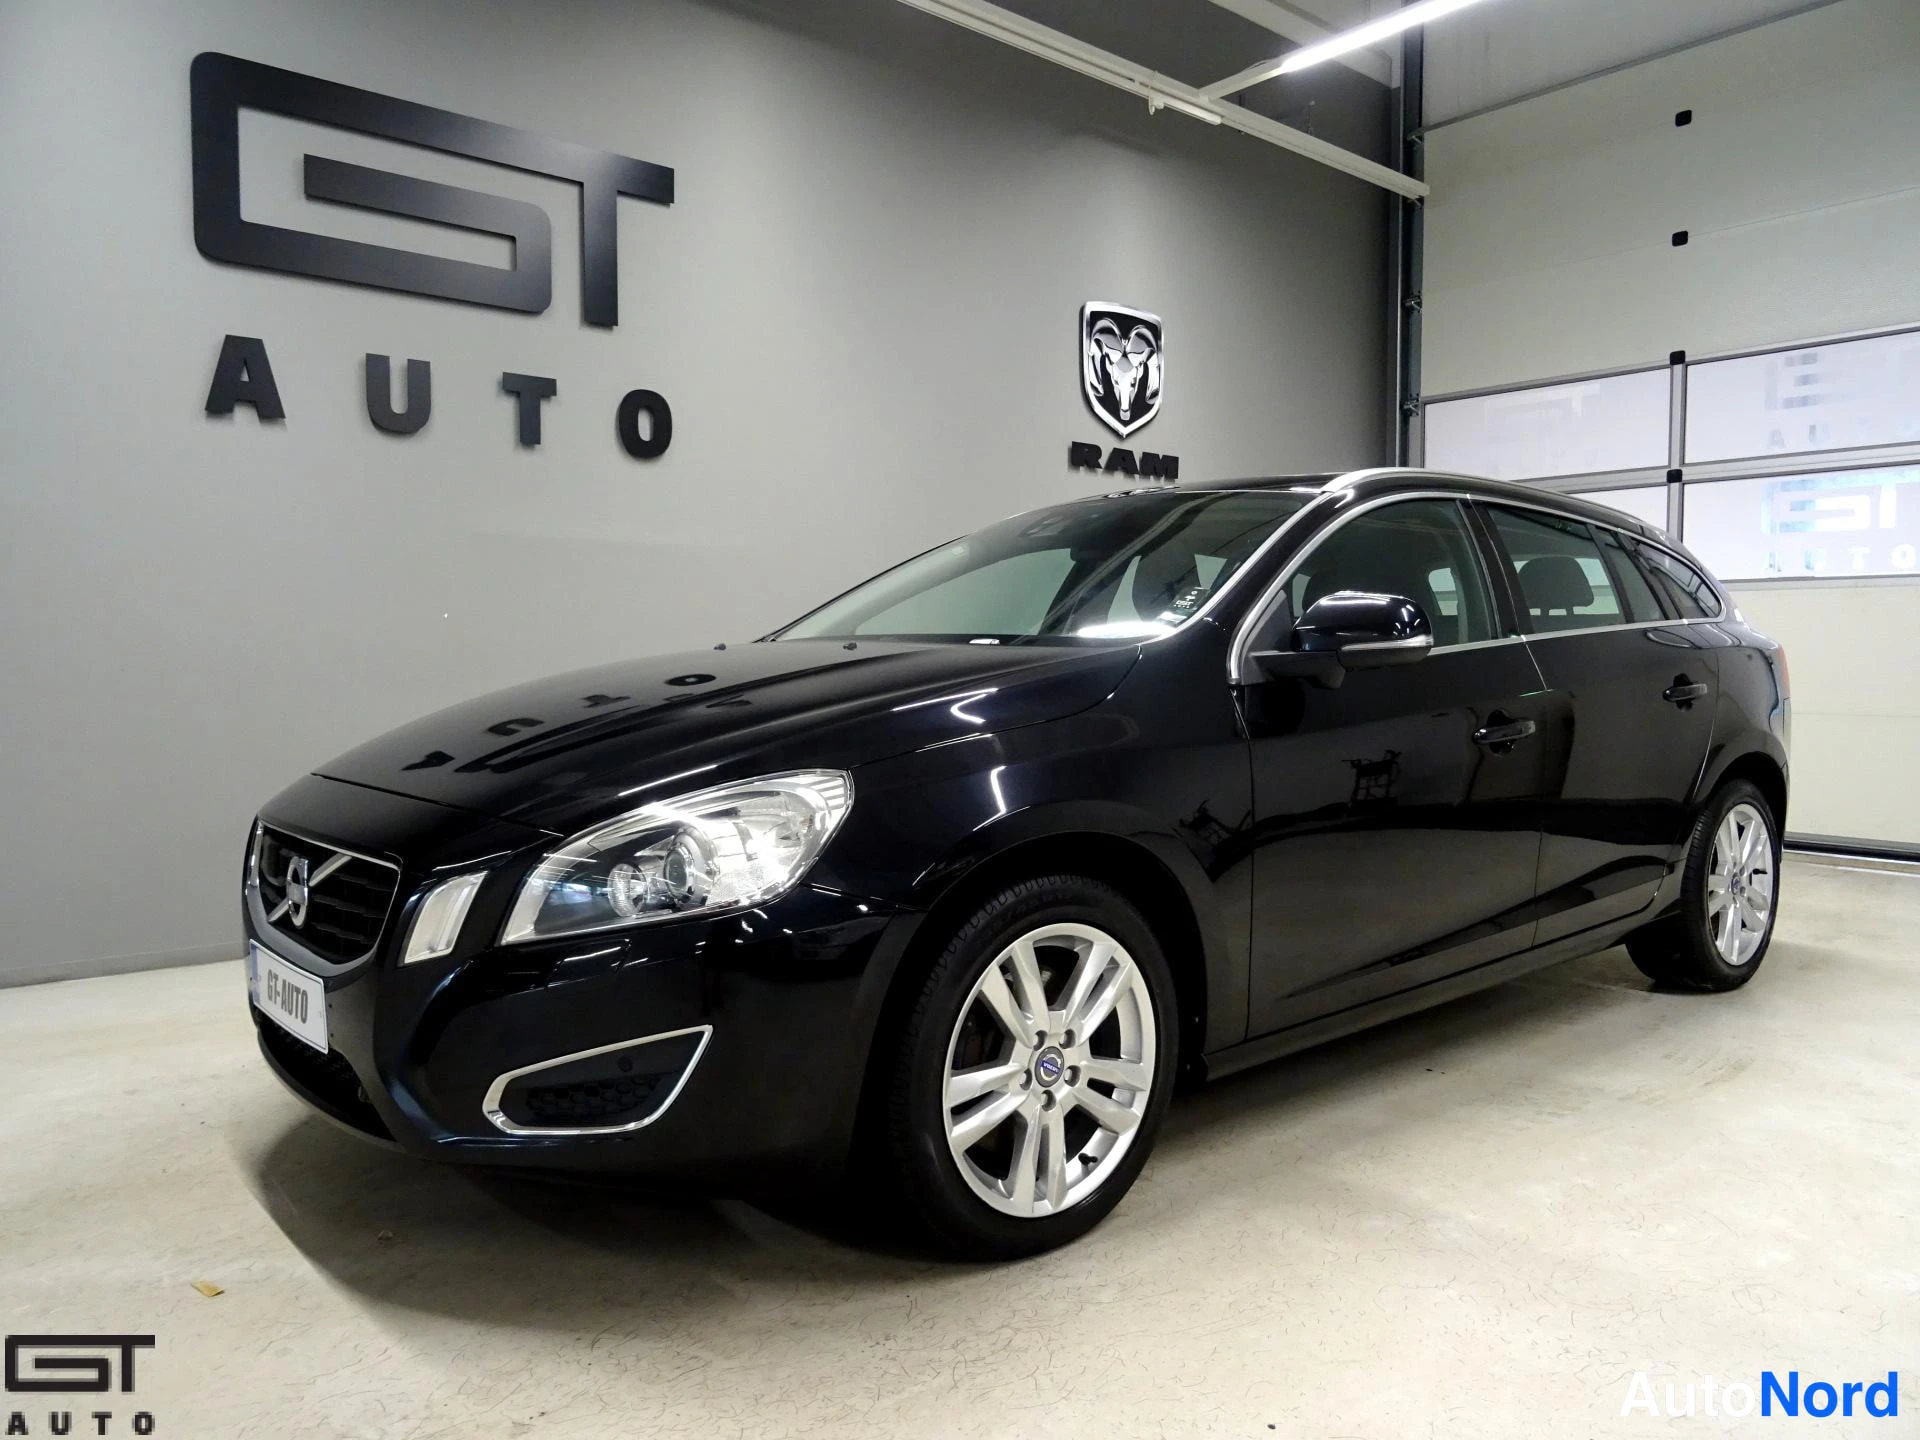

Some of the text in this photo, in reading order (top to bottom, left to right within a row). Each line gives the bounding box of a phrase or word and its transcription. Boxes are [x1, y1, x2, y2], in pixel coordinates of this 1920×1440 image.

[189, 51, 675, 328] GT
[204, 334, 673, 459] AUTO
[1070, 441, 1179, 480] RAM
[267, 969, 309, 1025] GT-AUTO
